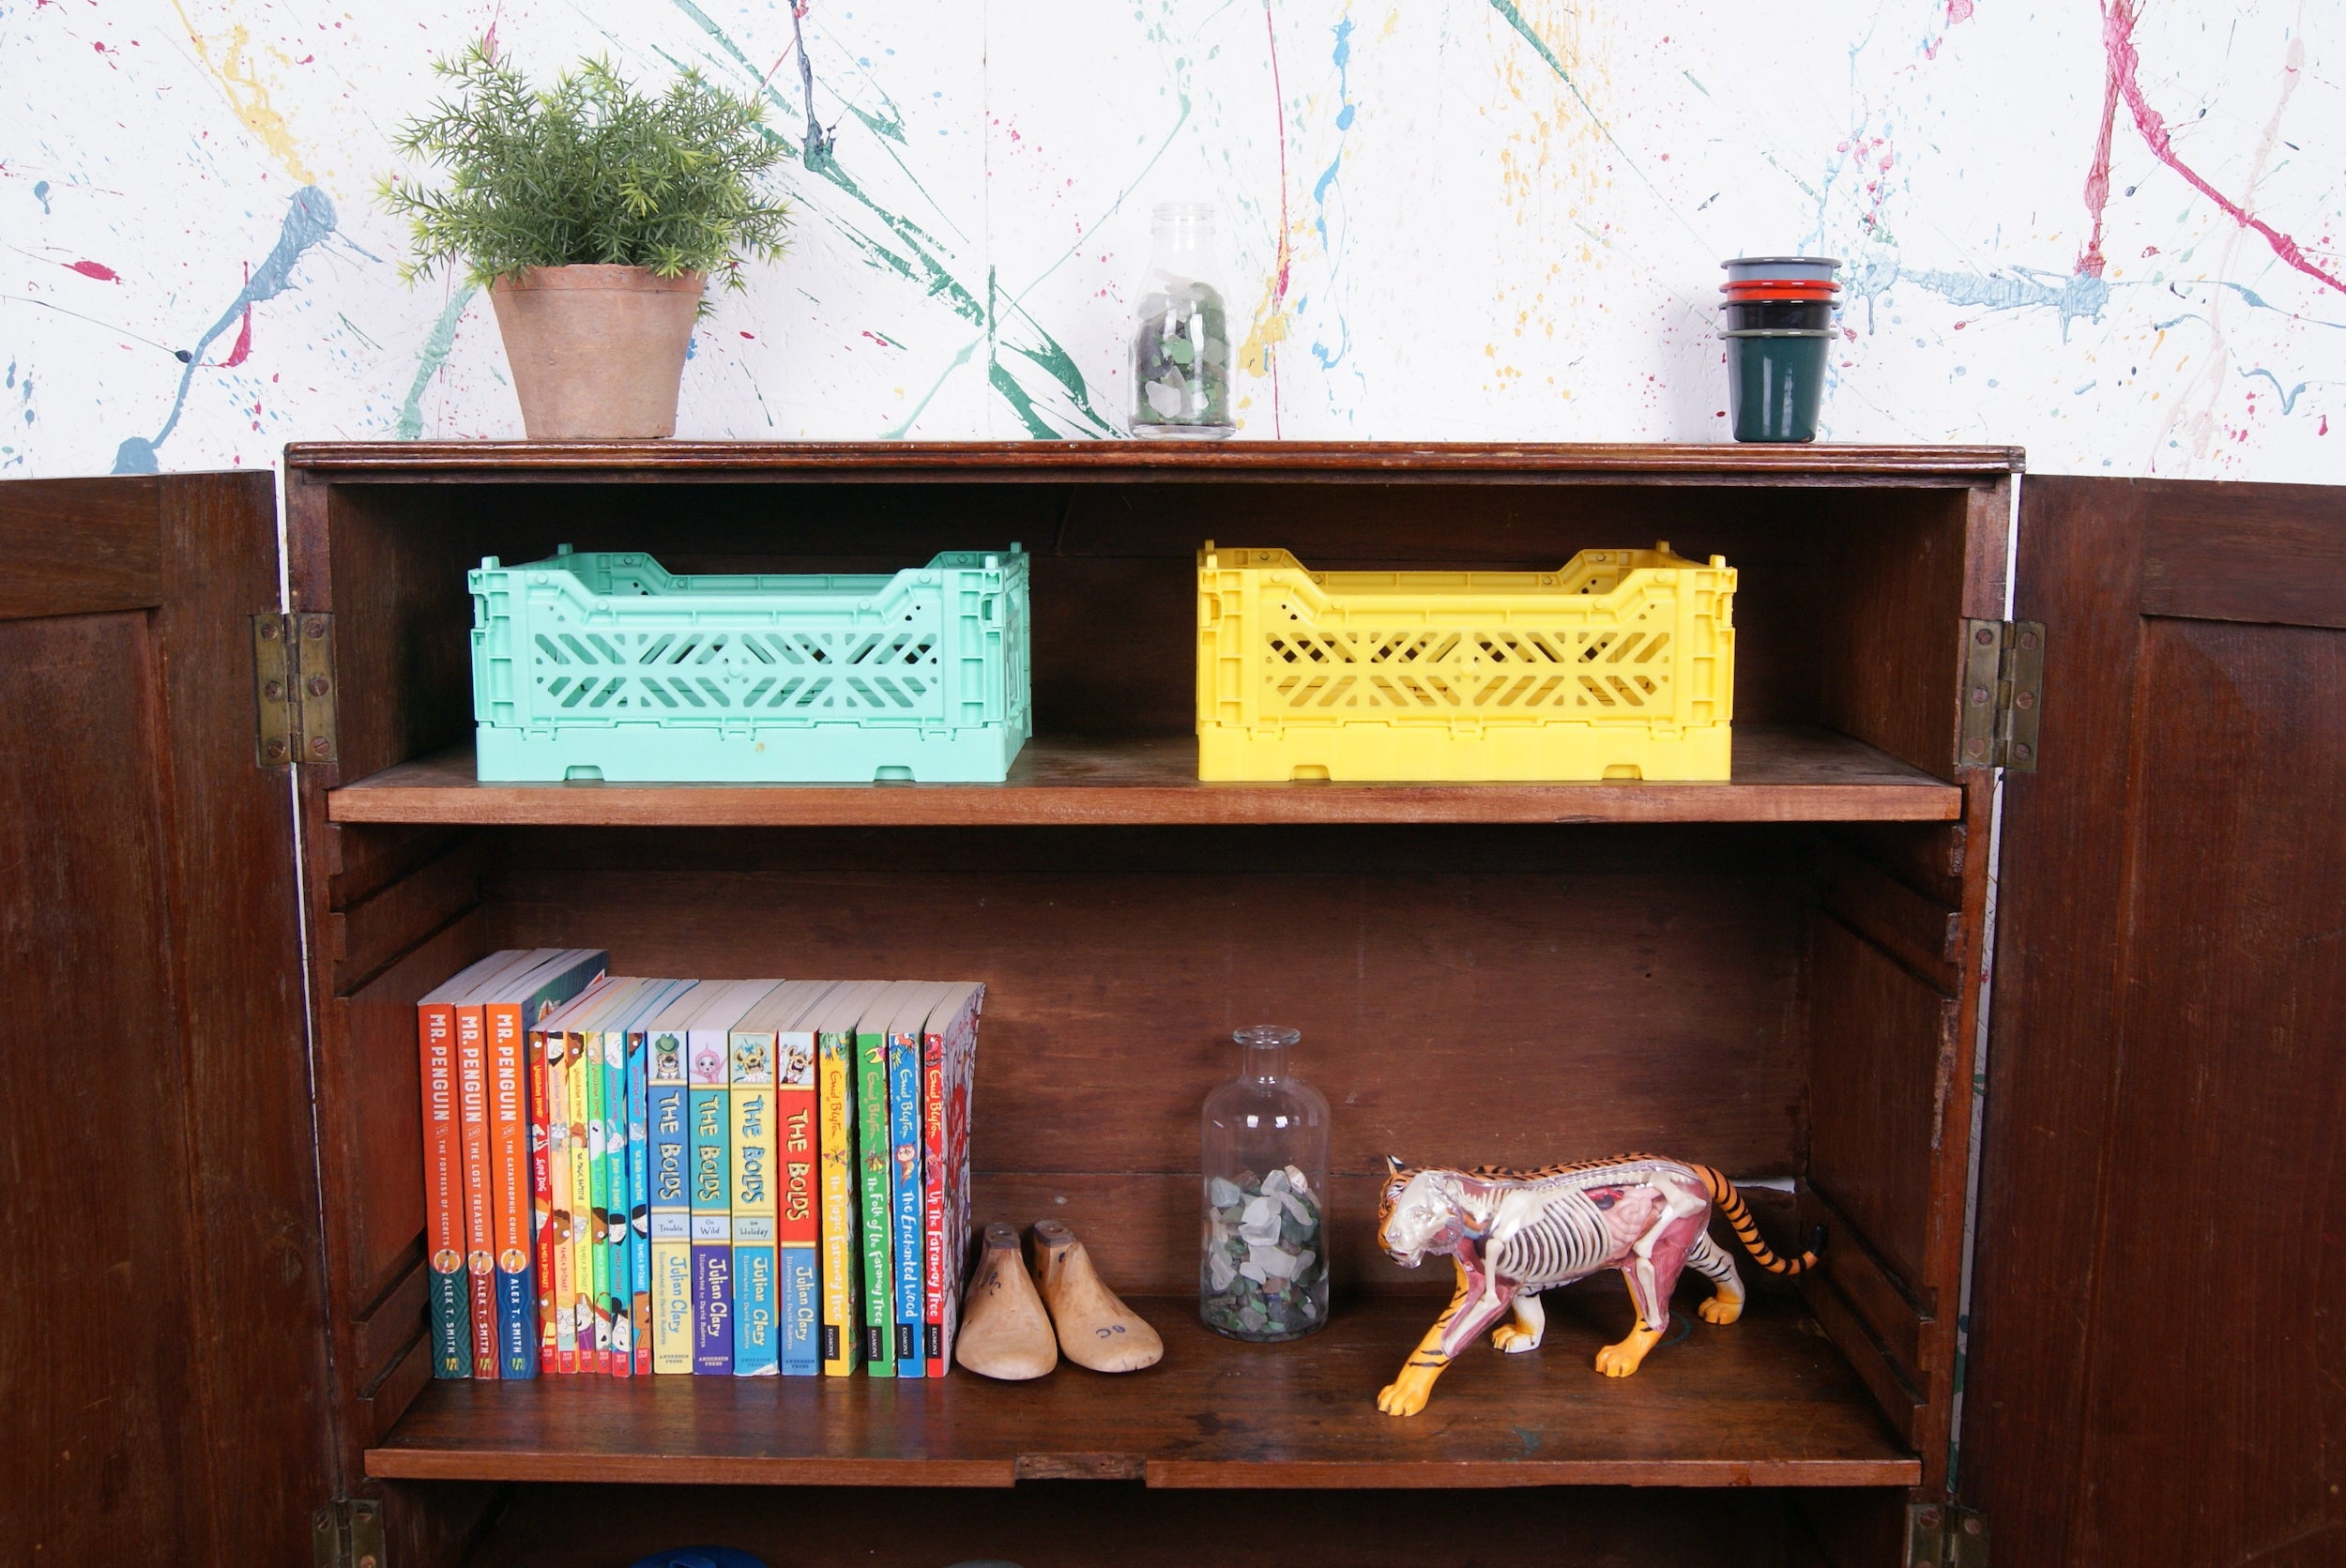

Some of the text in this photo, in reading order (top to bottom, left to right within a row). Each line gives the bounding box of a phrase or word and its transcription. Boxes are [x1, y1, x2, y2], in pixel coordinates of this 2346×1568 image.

[431, 1014, 446, 1043] MR.
[462, 1016, 478, 1045] MR.
[497, 1014, 513, 1043] MR.
[432, 1046, 449, 1121] PENGUIN
[463, 1048, 481, 1122] PENGUIN
[498, 1046, 517, 1121] PENGUIN
[828, 1071, 843, 1137] Enid Blyton
[865, 1072, 880, 1140] Enid Blyton
[899, 1069, 914, 1139] Enid Blyton
[927, 1069, 942, 1138] Enid Blyton
[439, 1157, 448, 1196] FORTRESS
[470, 1141, 480, 1160] THE
[471, 1165, 480, 1188] LOST
[658, 1090, 682, 1201] THE BOLDS
[697, 1094, 721, 1201] THE BOLDS
[741, 1094, 766, 1204] THE BOLDS
[785, 1107, 811, 1222] THE BOLDS
[441, 1199, 449, 1208] OF
[473, 1194, 483, 1243] TREASURE
[507, 1157, 515, 1214] CATASTROPHIC
[537, 1176, 547, 1193] DOG
[441, 1212, 450, 1246] SECRETS
[659, 1224, 683, 1233] Trouble
[700, 1226, 720, 1235] Wild
[739, 1227, 769, 1238] Holiday
[829, 1177, 845, 1321] The Magic Faraway Tree
[866, 1177, 885, 1325] The Folk of the Faraway Tree
[900, 1189, 919, 1317] The Enchanted Wood
[927, 1191, 943, 1317] Up The Faraway Tree
[444, 1279, 456, 1353] ALEX T. SMITH
[478, 1279, 489, 1354] ALEX T. SMITH
[510, 1279, 522, 1353] ALEX T. SMITH
[668, 1256, 688, 1333] Julian Clary
[708, 1258, 728, 1337] Julian Clary
[752, 1257, 769, 1346] Julian Clary
[795, 1267, 815, 1341] Julian Clary
